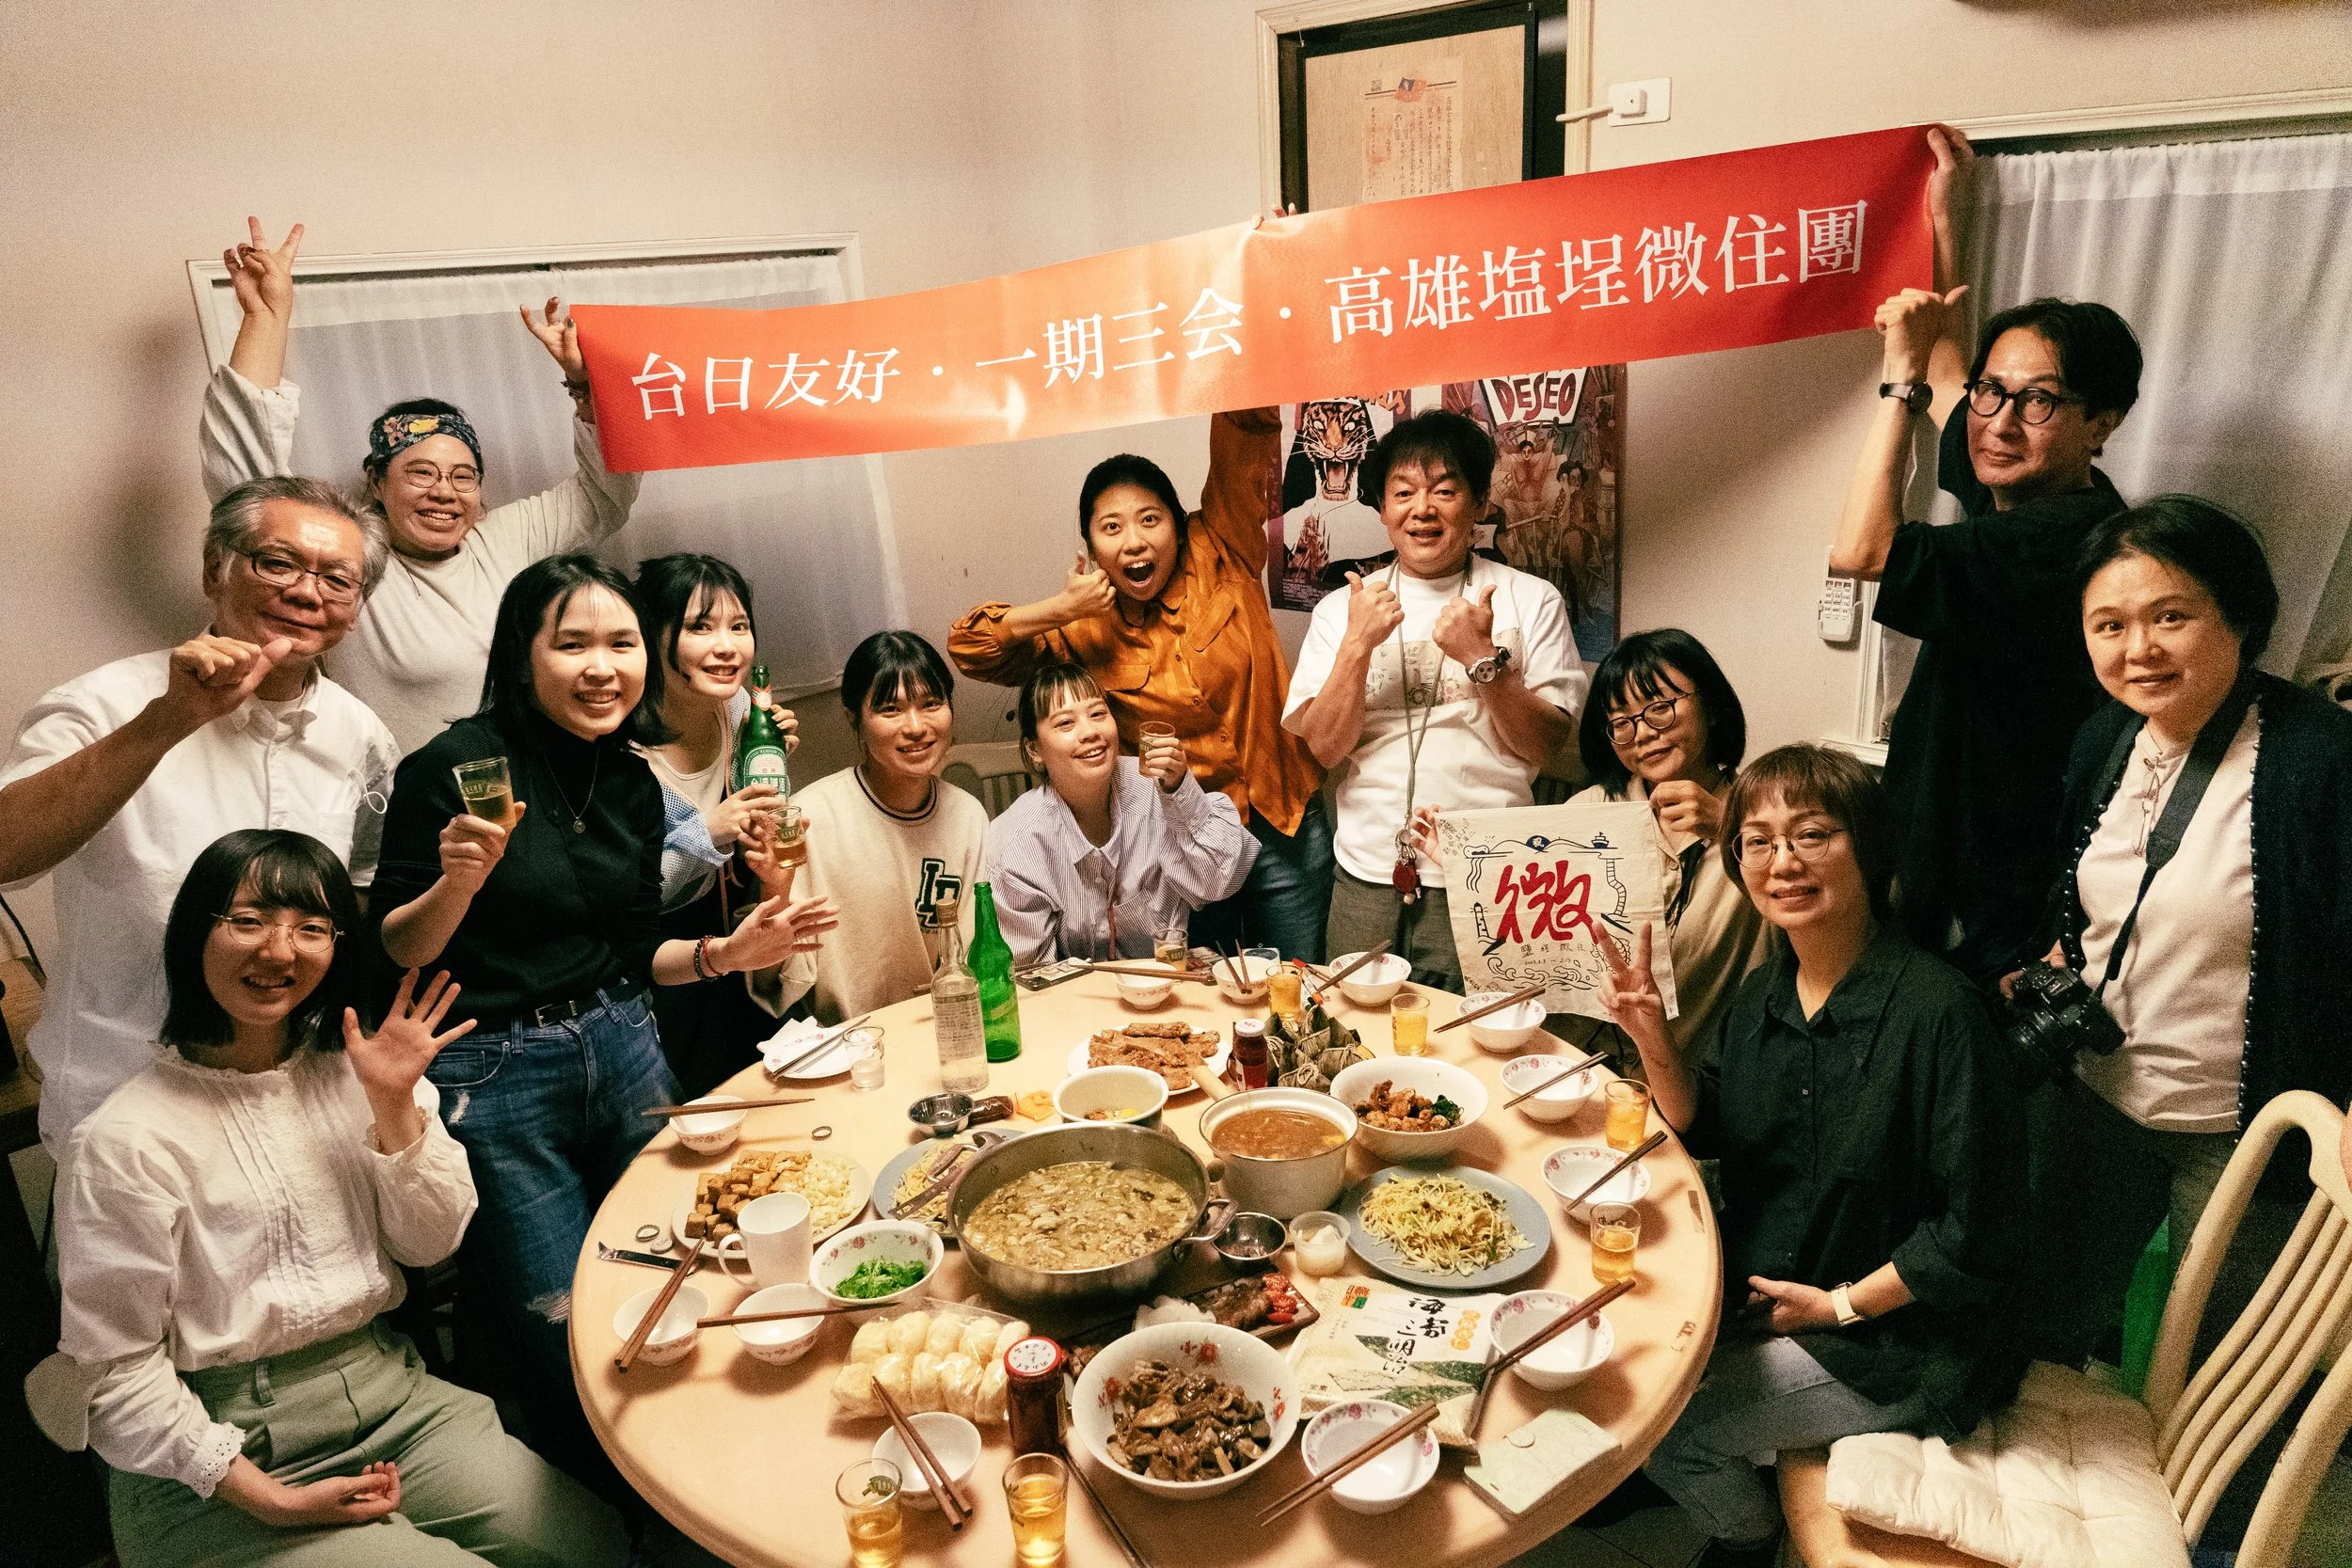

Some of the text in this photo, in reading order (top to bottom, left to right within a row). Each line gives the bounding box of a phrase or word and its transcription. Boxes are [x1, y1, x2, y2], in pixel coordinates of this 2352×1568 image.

[1490, 372, 1577, 421] DESEO
[1382, 1320, 1418, 1374] 三明治
